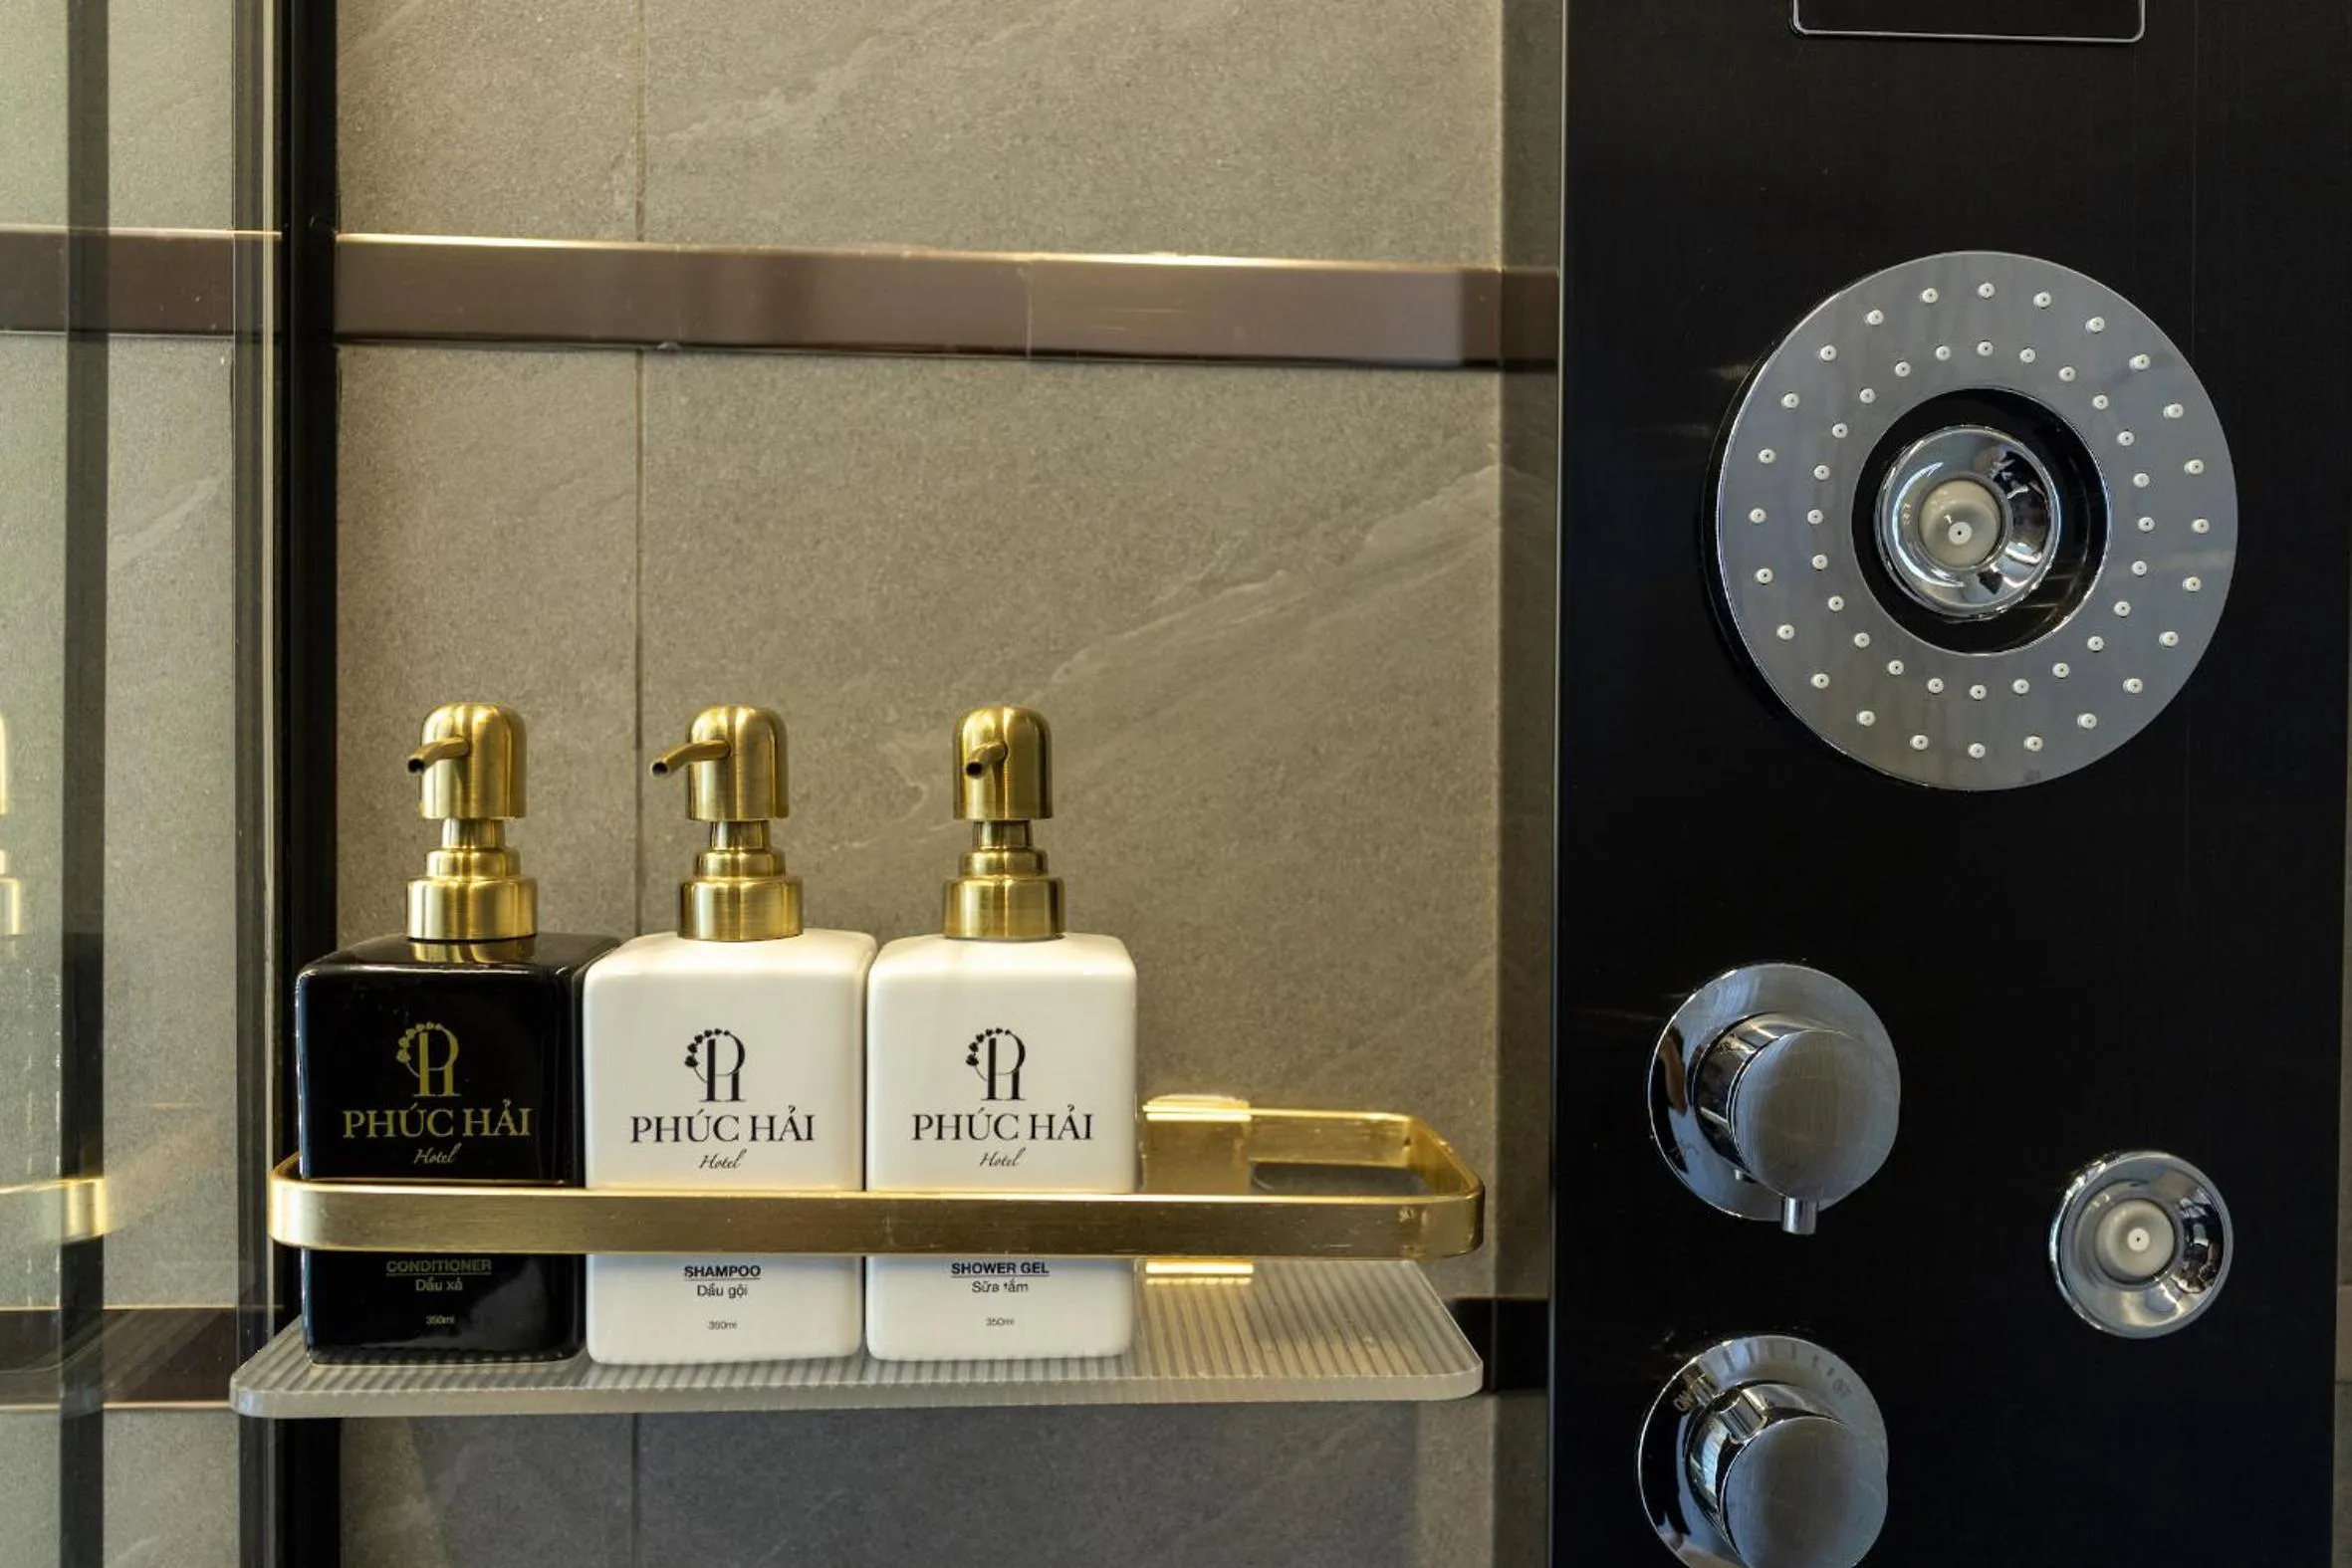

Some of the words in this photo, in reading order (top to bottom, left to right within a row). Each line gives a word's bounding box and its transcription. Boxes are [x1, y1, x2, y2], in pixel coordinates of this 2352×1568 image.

[343, 1102, 454, 1139] PHÚC
[461, 1098, 534, 1138] HẢI
[629, 1108, 740, 1144] PHÚC
[749, 1105, 816, 1142] HẢI
[911, 1107, 1019, 1141] PHÚC
[1029, 1104, 1094, 1140] HẢI
[413, 1142, 462, 1164] Hotel
[699, 1148, 747, 1170] Hotel
[979, 1147, 1027, 1167] Hotel
[385, 1258, 493, 1273] CONDITIONER
[684, 1264, 762, 1277] SHAMPOO
[951, 1262, 1017, 1274] SHOWER
[1021, 1261, 1050, 1274] GEL
